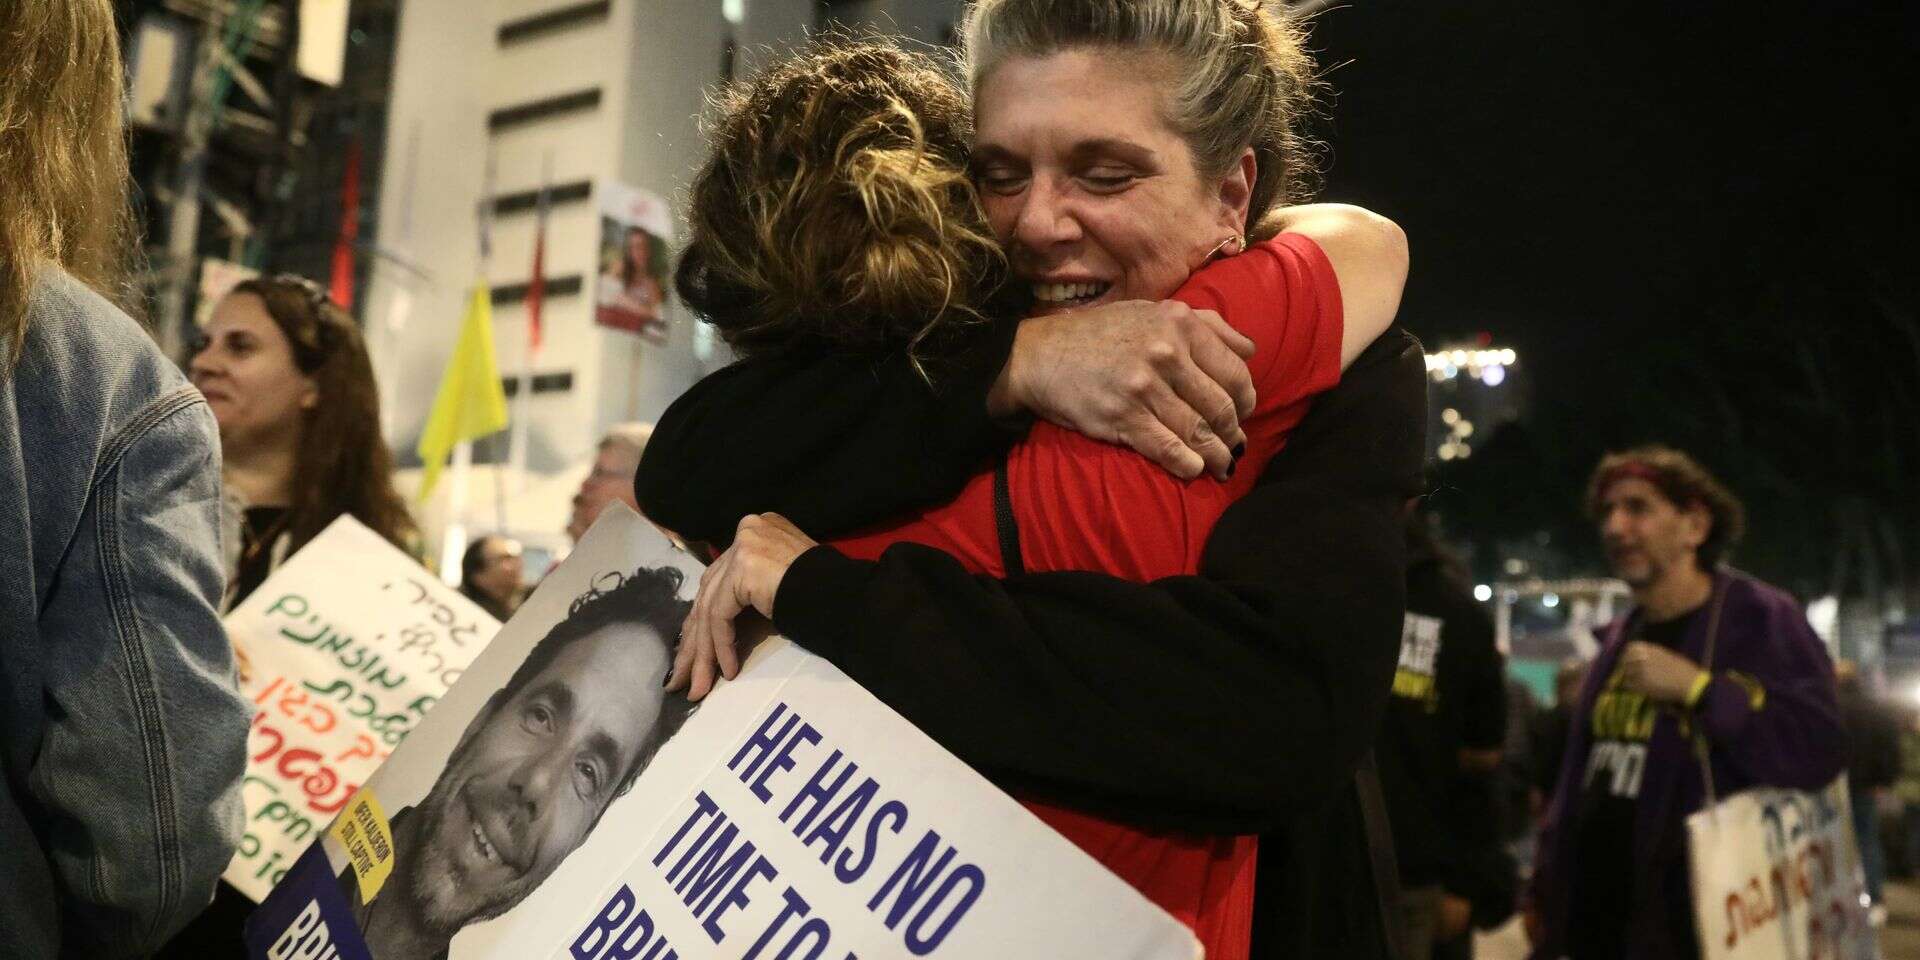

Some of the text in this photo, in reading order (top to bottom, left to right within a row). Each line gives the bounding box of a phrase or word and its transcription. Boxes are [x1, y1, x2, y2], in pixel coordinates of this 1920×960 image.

[265, 595, 407, 688] מוזמנים
[351, 840, 374, 878] CAPTIVE
[364, 818, 391, 864] KALDERON
[652, 790, 830, 960] TIME TO
[727, 702, 985, 957] HE HAS NO
